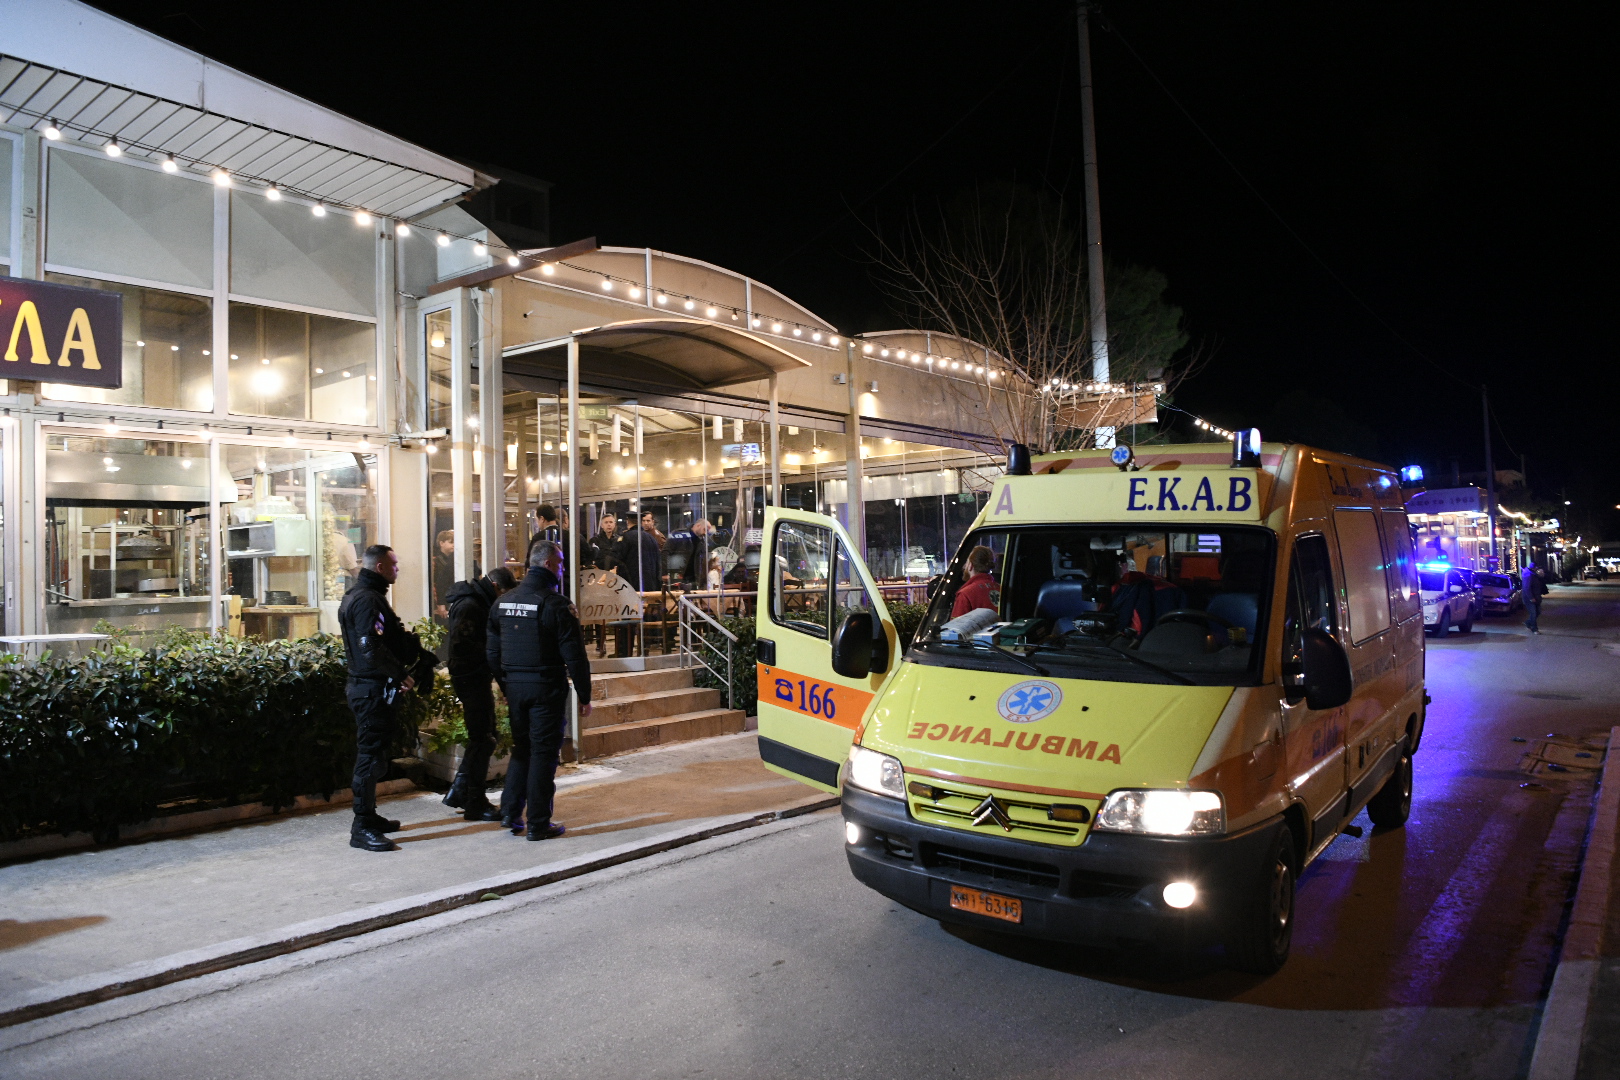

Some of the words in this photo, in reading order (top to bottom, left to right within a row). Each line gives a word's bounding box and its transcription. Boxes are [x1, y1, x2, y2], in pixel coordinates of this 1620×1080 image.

[0, 299, 102, 370] ΛΑ
[505, 609, 528, 617] ΔΙΑΣ
[581, 603, 639, 618] ΟΠΟΥΛΑ
[798, 680, 836, 719] 166
